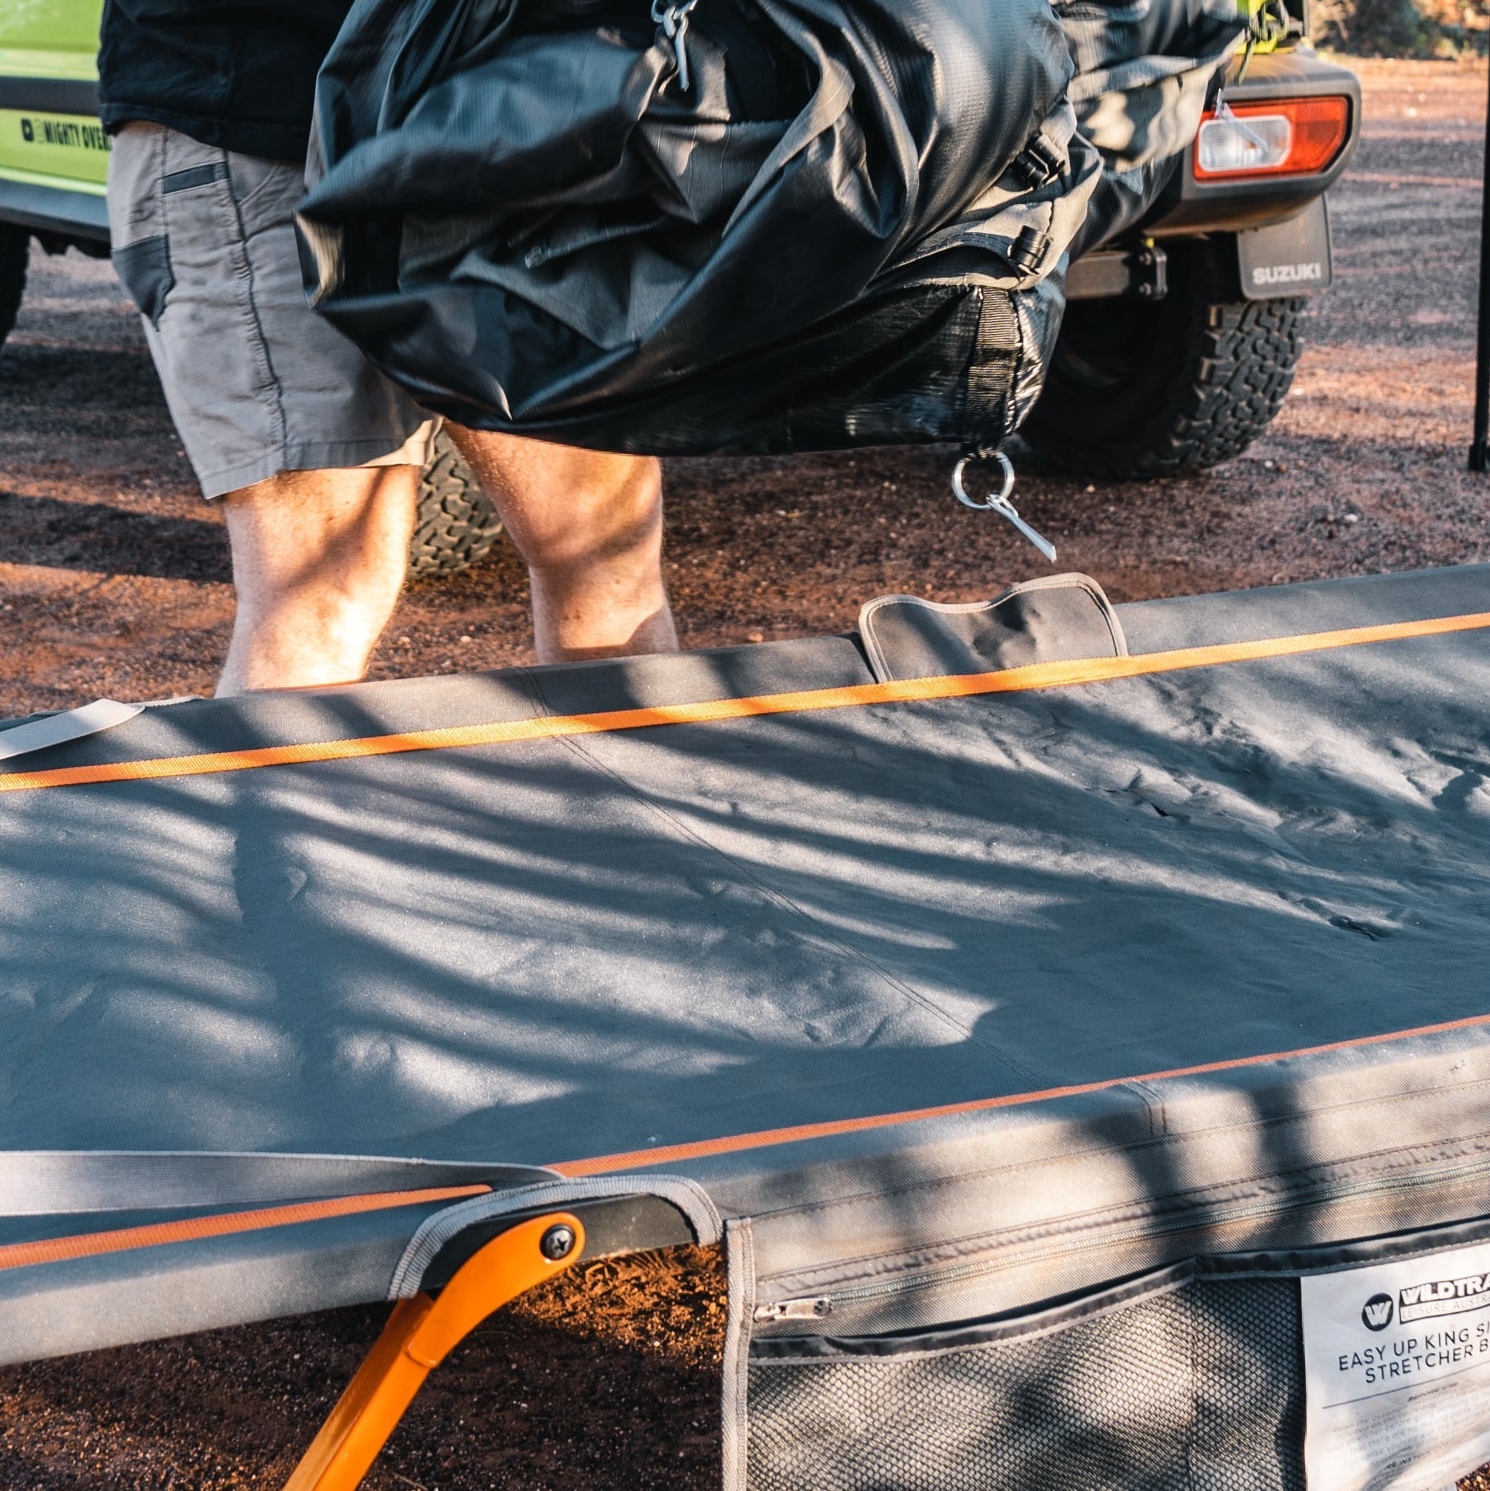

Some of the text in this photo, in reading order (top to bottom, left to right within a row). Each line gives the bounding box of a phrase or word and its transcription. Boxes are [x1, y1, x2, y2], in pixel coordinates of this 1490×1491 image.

[44, 120, 81, 147] MIGHTY
[1252, 263, 1321, 285] SUZUKI
[1401, 1303, 1447, 1319] LEISURE
[1338, 1344, 1386, 1372] EASY
[1393, 1338, 1418, 1356] UP
[1425, 1328, 1470, 1350] KING
[1365, 1344, 1474, 1384] STRETCHER
